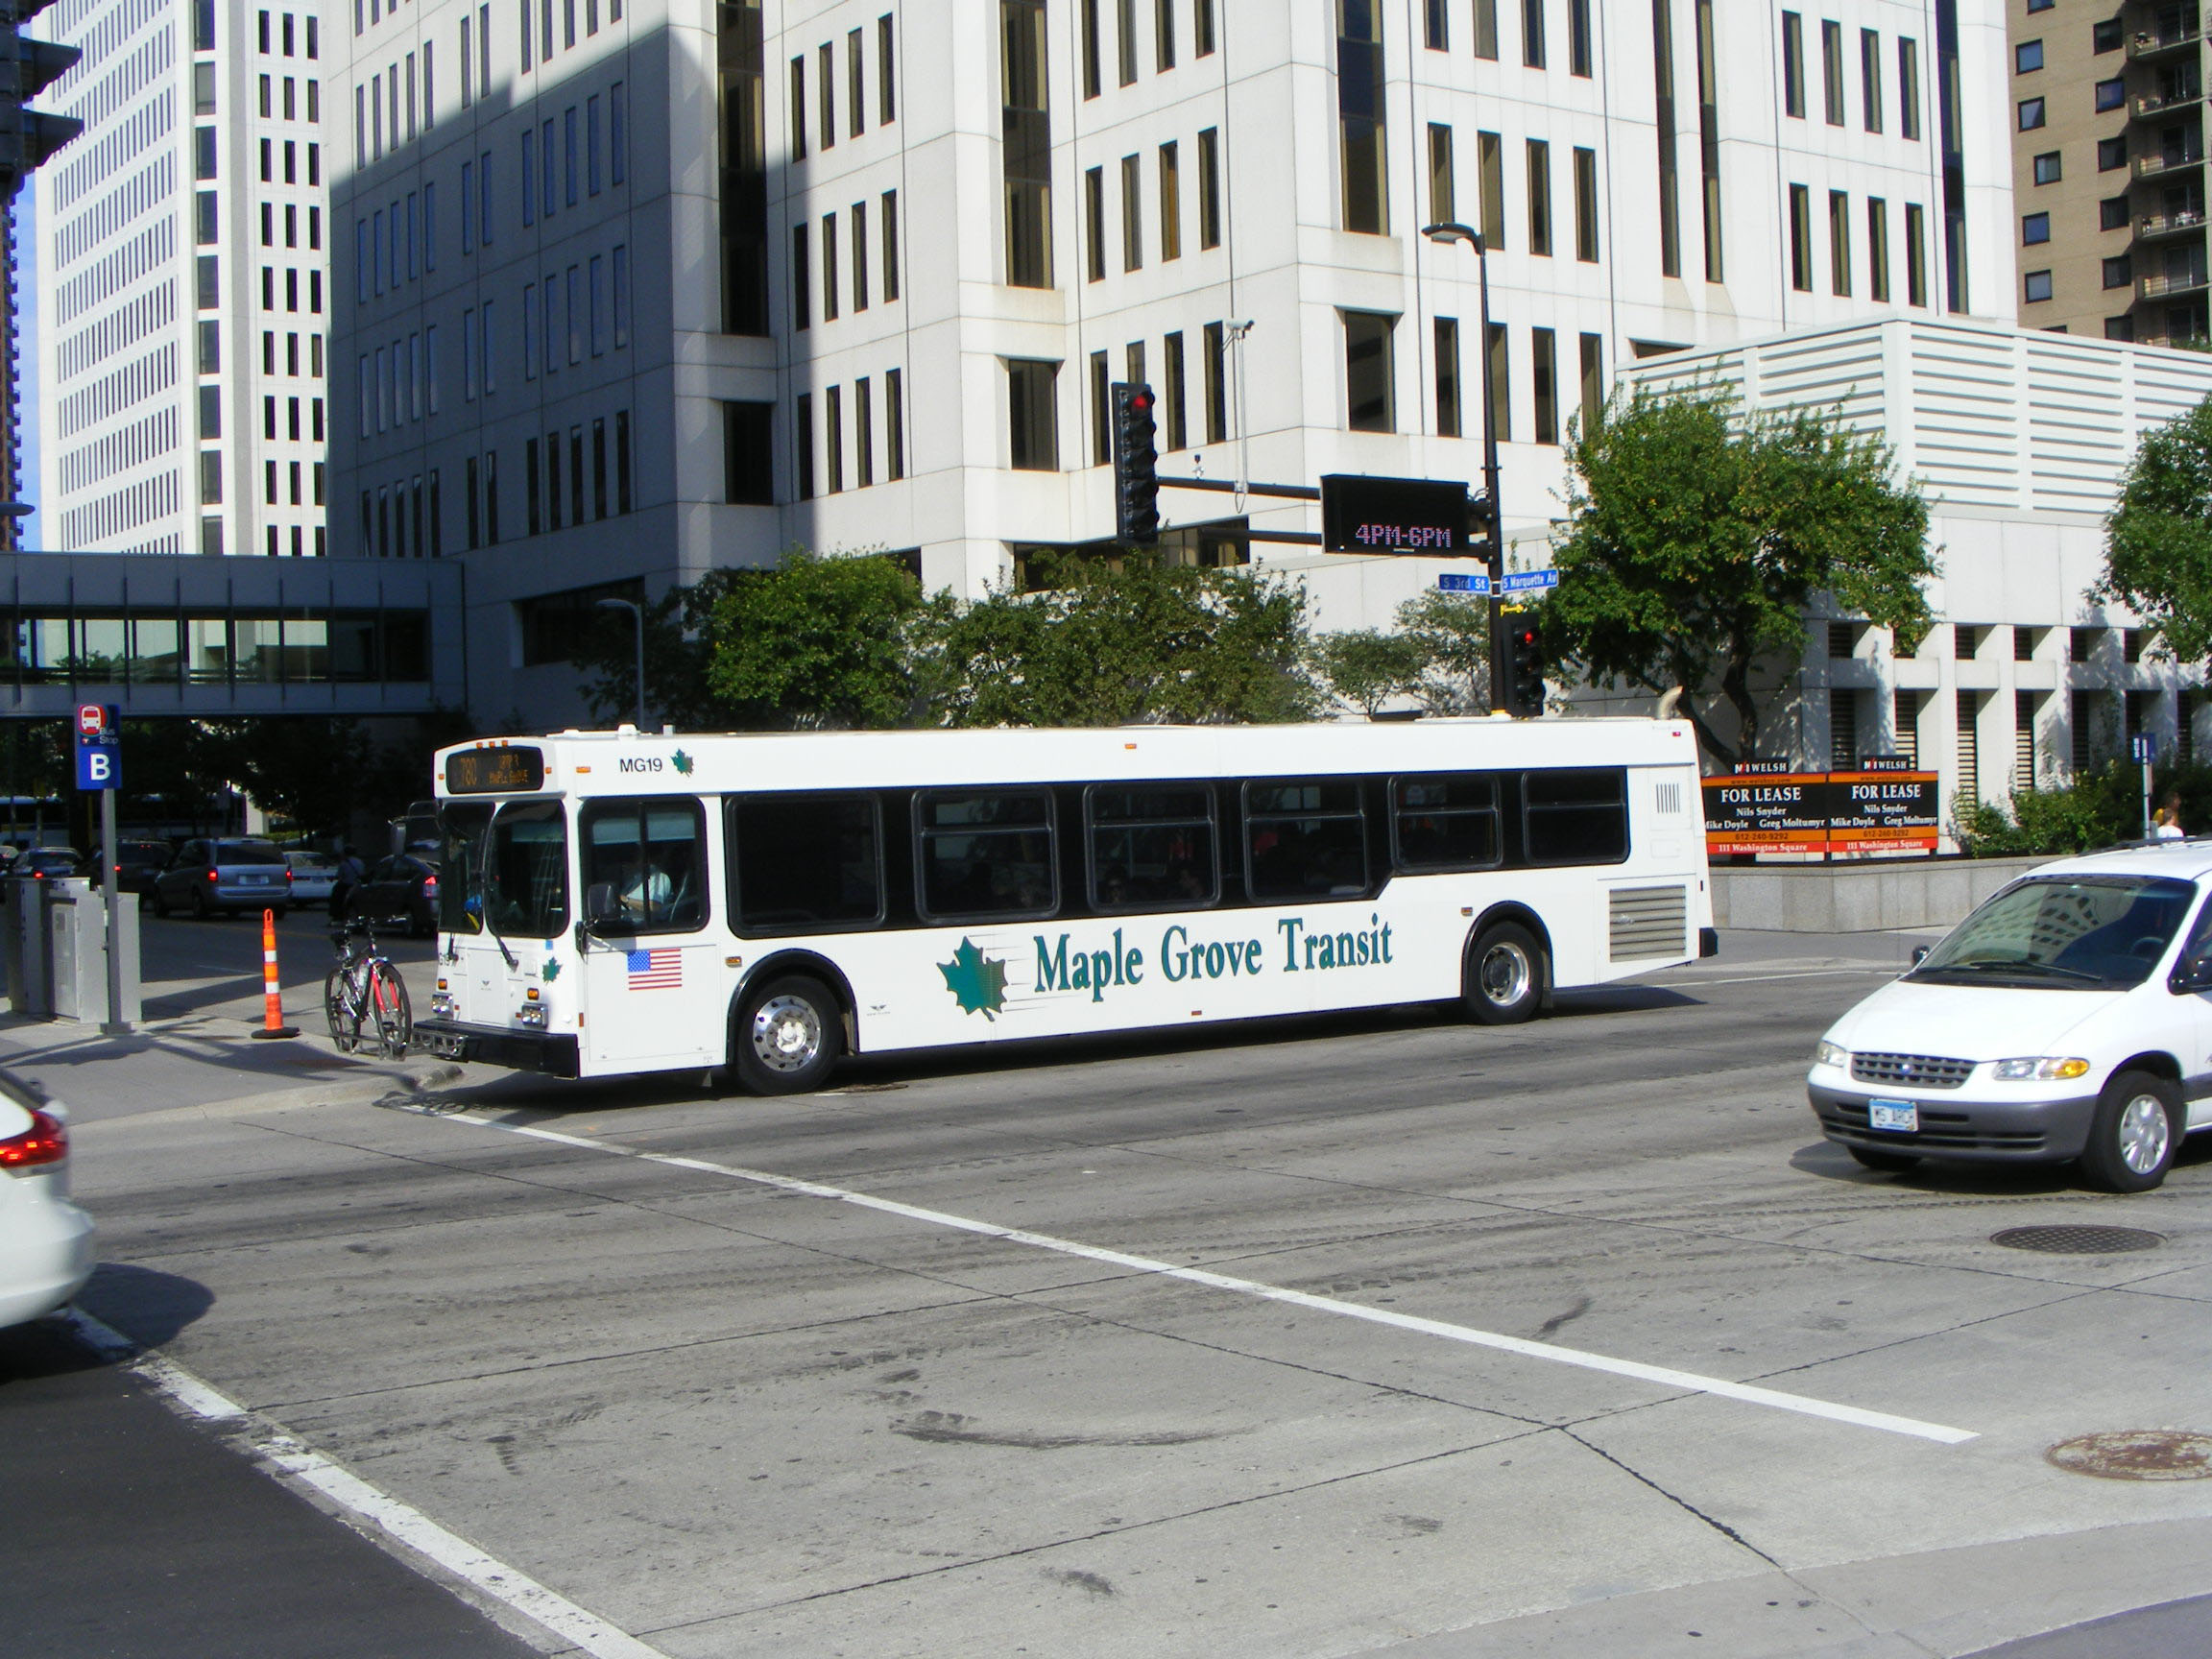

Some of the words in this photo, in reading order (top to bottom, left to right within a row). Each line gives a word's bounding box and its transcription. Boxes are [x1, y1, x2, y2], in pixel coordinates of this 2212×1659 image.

[1356, 524, 1451, 548] 4PM-6PM
[1443, 577, 1450, 589] S
[1455, 577, 1470, 589] 3rd
[1475, 578, 1485, 589] St
[1503, 577, 1508, 589] S
[1510, 574, 1544, 588] Marquette
[99, 735, 119, 745] Stop
[90, 754, 110, 781] B
[619, 757, 662, 773] MG19
[1751, 763, 1787, 773] WELSH
[1878, 760, 1908, 769] WELSH
[1720, 788, 1750, 803] FOR
[1755, 787, 1802, 802] LEASE
[1851, 784, 1879, 799] FOR
[1882, 784, 1921, 798] LEASE
[1736, 807, 1755, 817] Nils
[1756, 806, 1787, 818] Snyder
[1863, 805, 1881, 813] Nils
[1882, 804, 1908, 815] Snyder
[1724, 819, 1748, 830] Doyle
[1759, 818, 1781, 830] Greg
[1830, 818, 1852, 827] Mike
[1852, 817, 1876, 828] Doyle
[1884, 816, 1903, 827] Greg
[1719, 844, 1730, 853] 111
[1732, 843, 1778, 854] Washington
[1780, 843, 1808, 854] Square
[1846, 841, 1858, 850] 111
[1859, 841, 1898, 852] Washington
[1900, 839, 1923, 850] Square
[1033, 927, 1143, 1002] Maple
[1161, 925, 1262, 982] Grove
[1278, 912, 1393, 972] Transit
